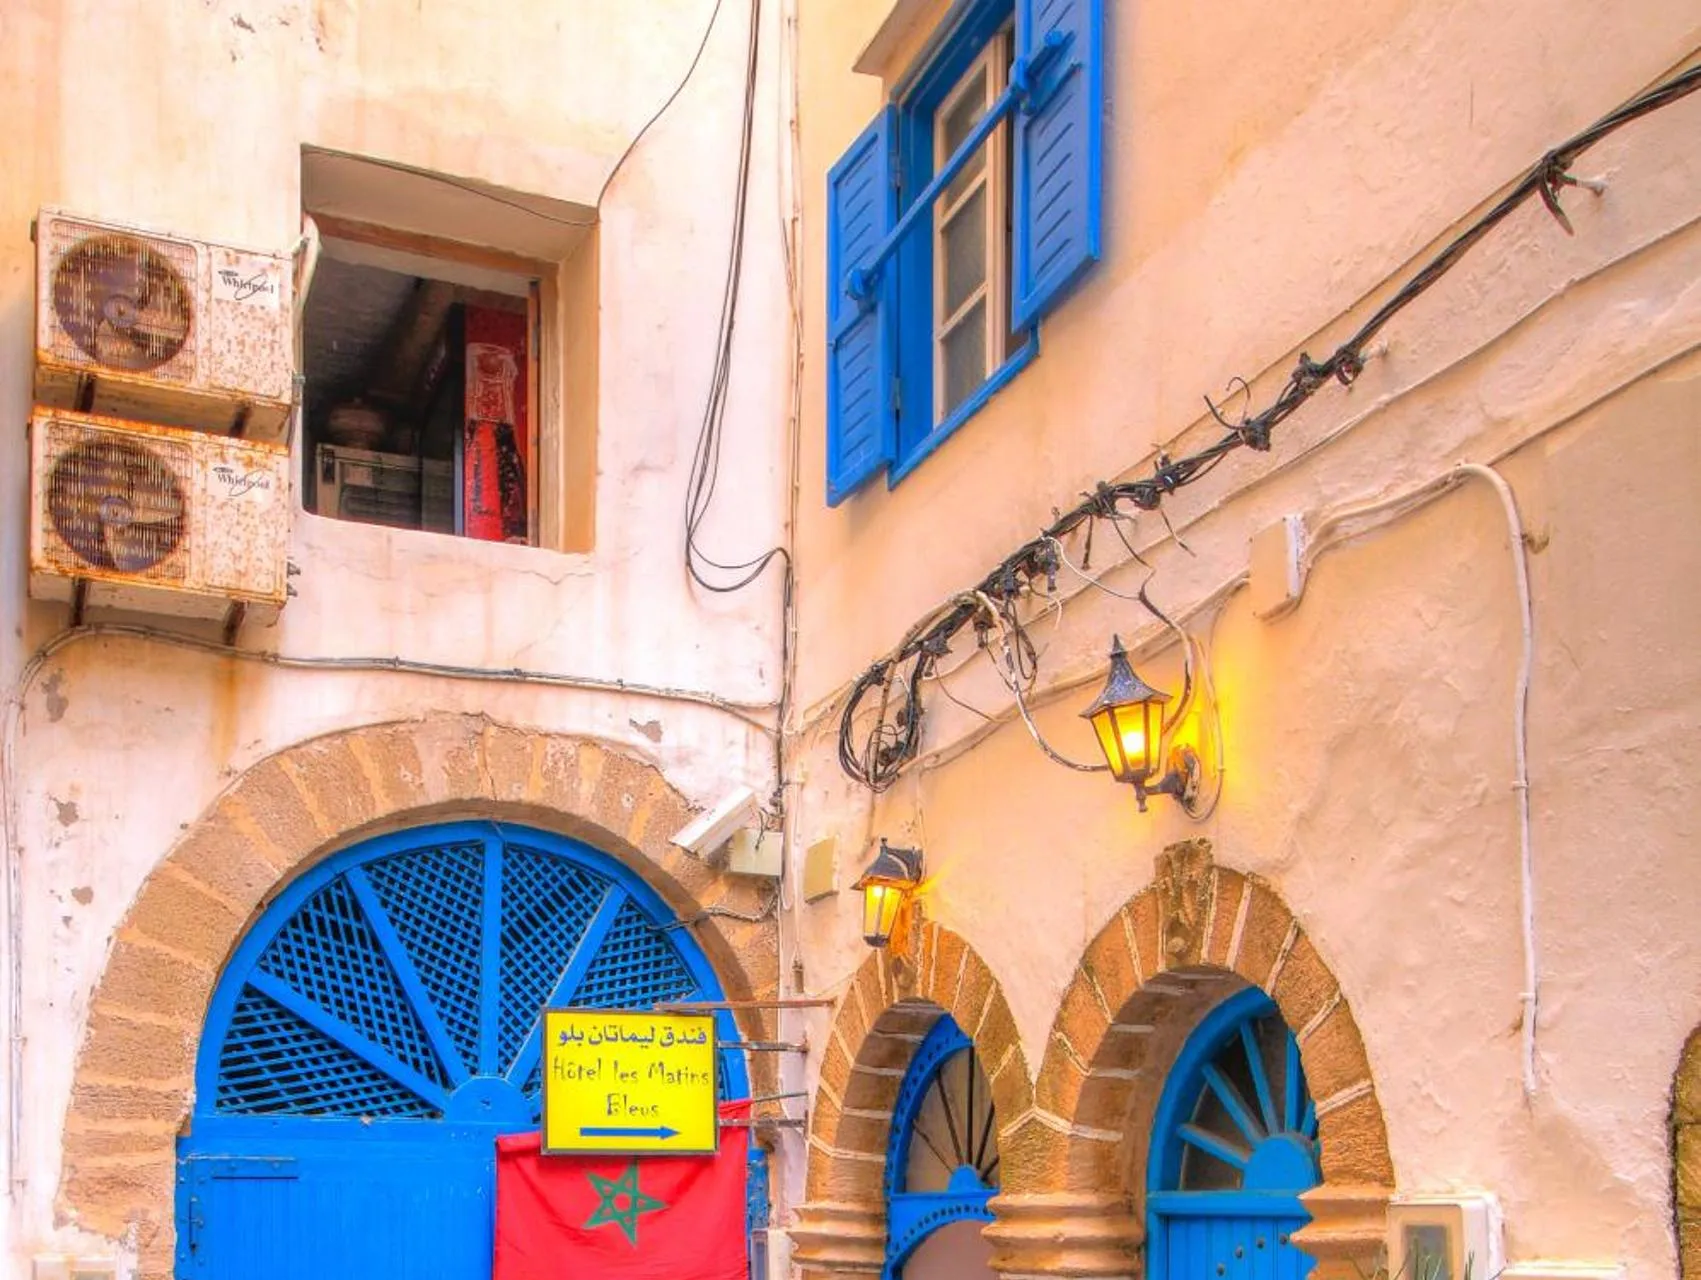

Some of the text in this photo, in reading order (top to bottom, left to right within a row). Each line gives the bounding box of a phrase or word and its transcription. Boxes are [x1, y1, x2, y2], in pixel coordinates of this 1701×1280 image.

[220, 273, 274, 295] Whirlpool
[217, 472, 270, 492] Whirlpool
[559, 1024, 708, 1049] فندق ليماتان بلو
[553, 1055, 710, 1086] Hôtel les Matins
[606, 1092, 659, 1118] Bleus
